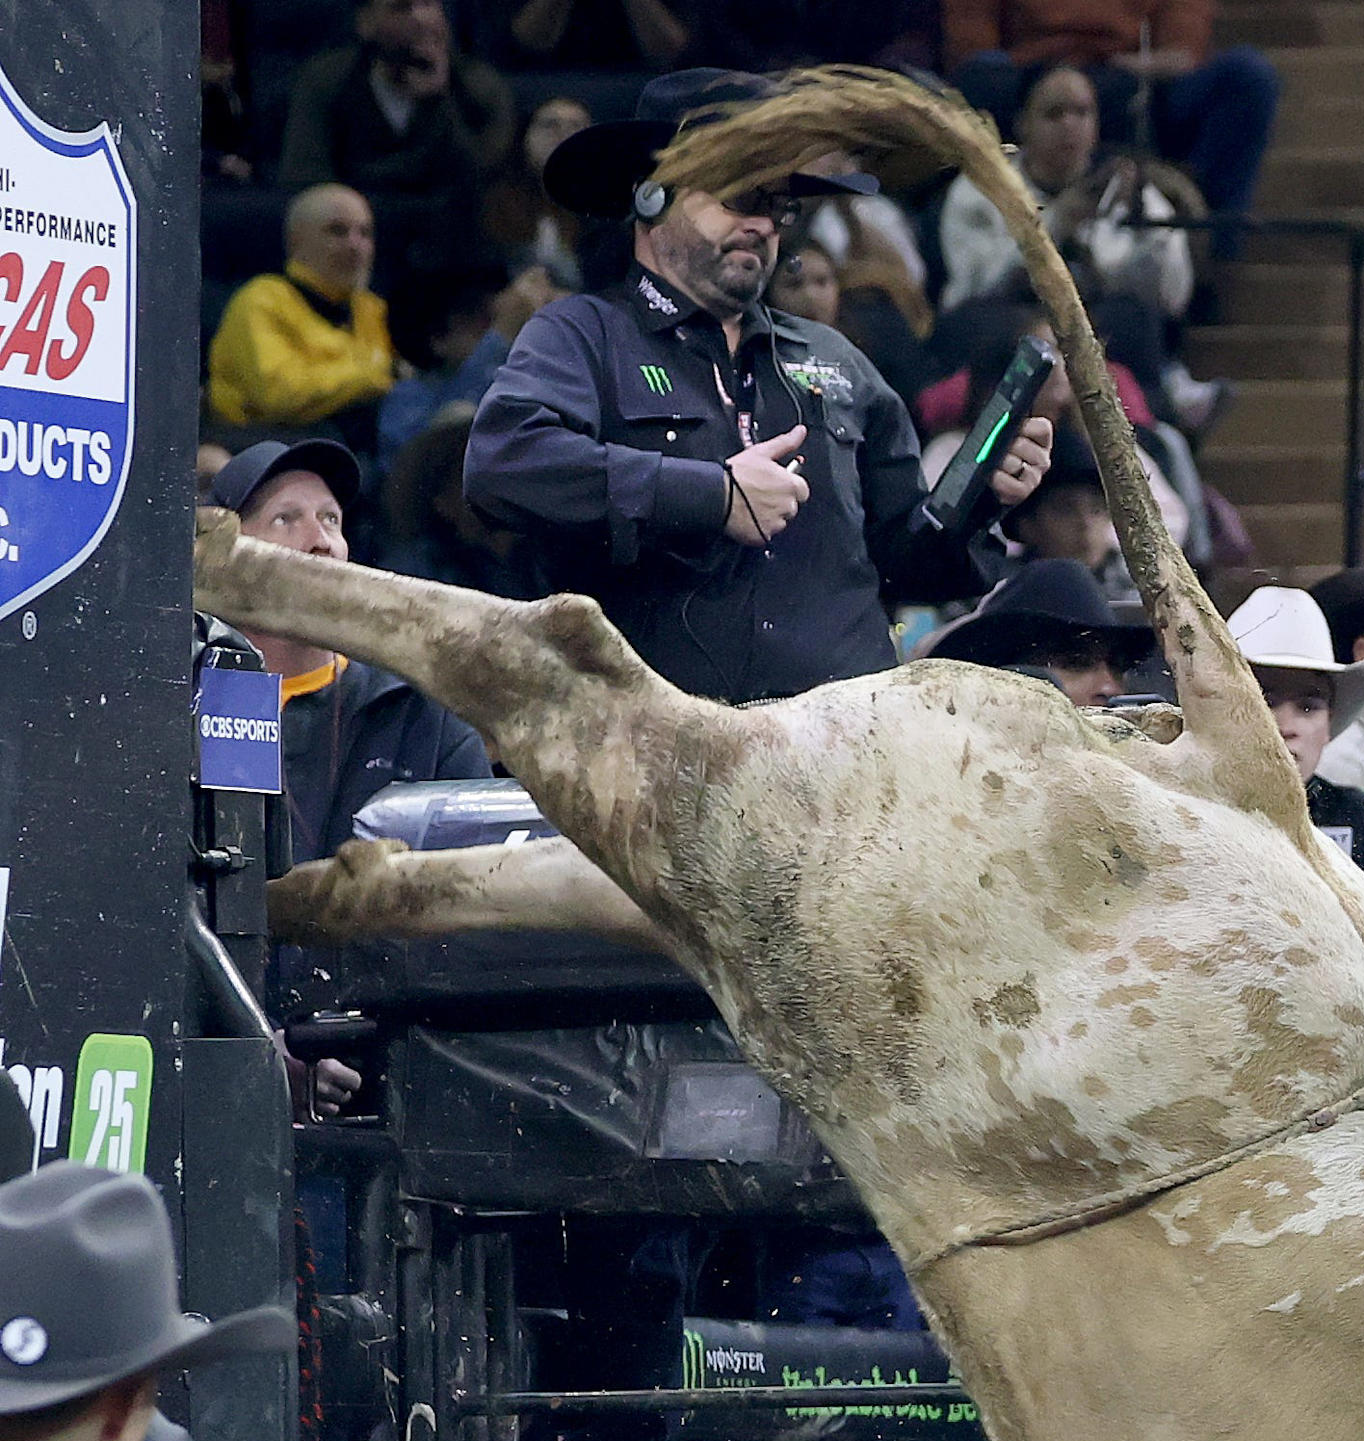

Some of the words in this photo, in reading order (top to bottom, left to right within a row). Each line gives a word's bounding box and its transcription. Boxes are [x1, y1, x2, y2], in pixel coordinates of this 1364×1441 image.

[0, 206, 117, 248] ERFORMANCE
[210, 715, 233, 739] CBS
[233, 717, 279, 743] SPORTS
[84, 1069, 138, 1173] 25
